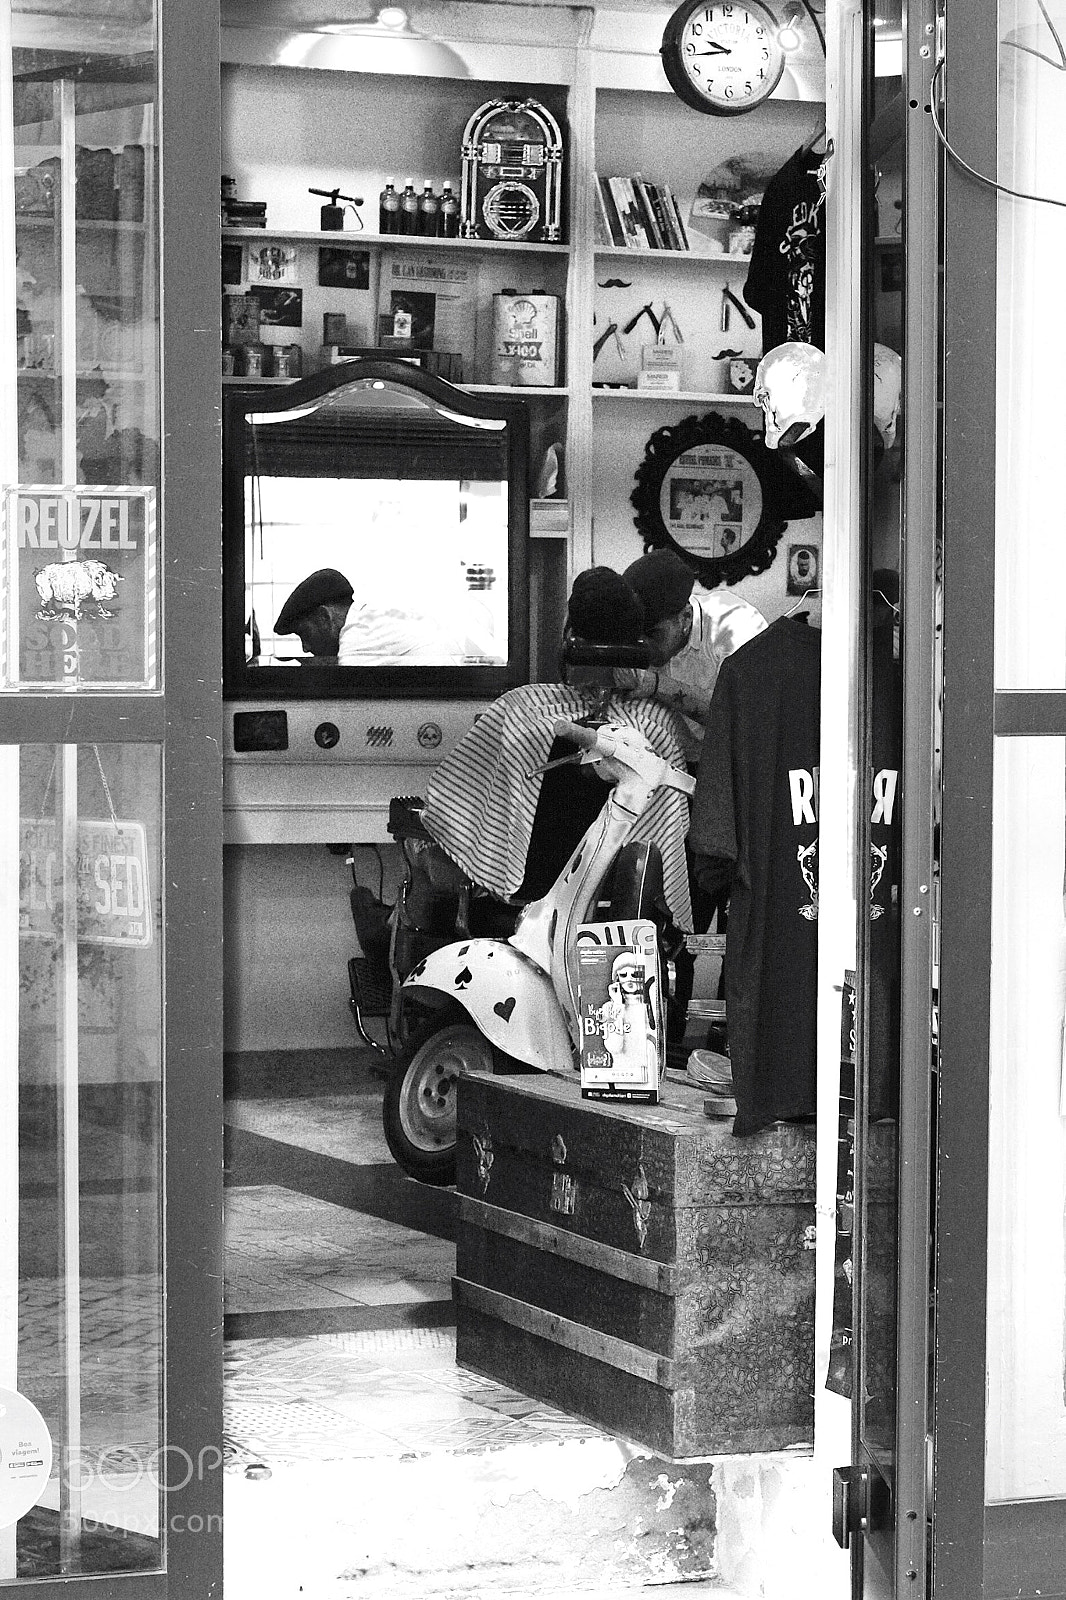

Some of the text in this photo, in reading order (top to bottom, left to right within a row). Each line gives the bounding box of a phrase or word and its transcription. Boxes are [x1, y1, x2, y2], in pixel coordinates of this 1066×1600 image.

[705, 9, 713, 22] 11
[723, 4, 733, 17] 12
[745, 12, 749, 24] 1
[692, 23, 703, 36] 10
[755, 26, 764, 40] 2
[685, 43, 696, 57] 9
[761, 47, 769, 61] 3
[692, 63, 701, 77] 8
[718, 65, 742, 73] LONDON
[755, 67, 765, 79] 4
[706, 79, 714, 92] 7
[724, 85, 734, 98] 6
[744, 81, 752, 95] 5
[17, 498, 137, 550] REUZEL
[584, 1016, 631, 1040] Bigode
